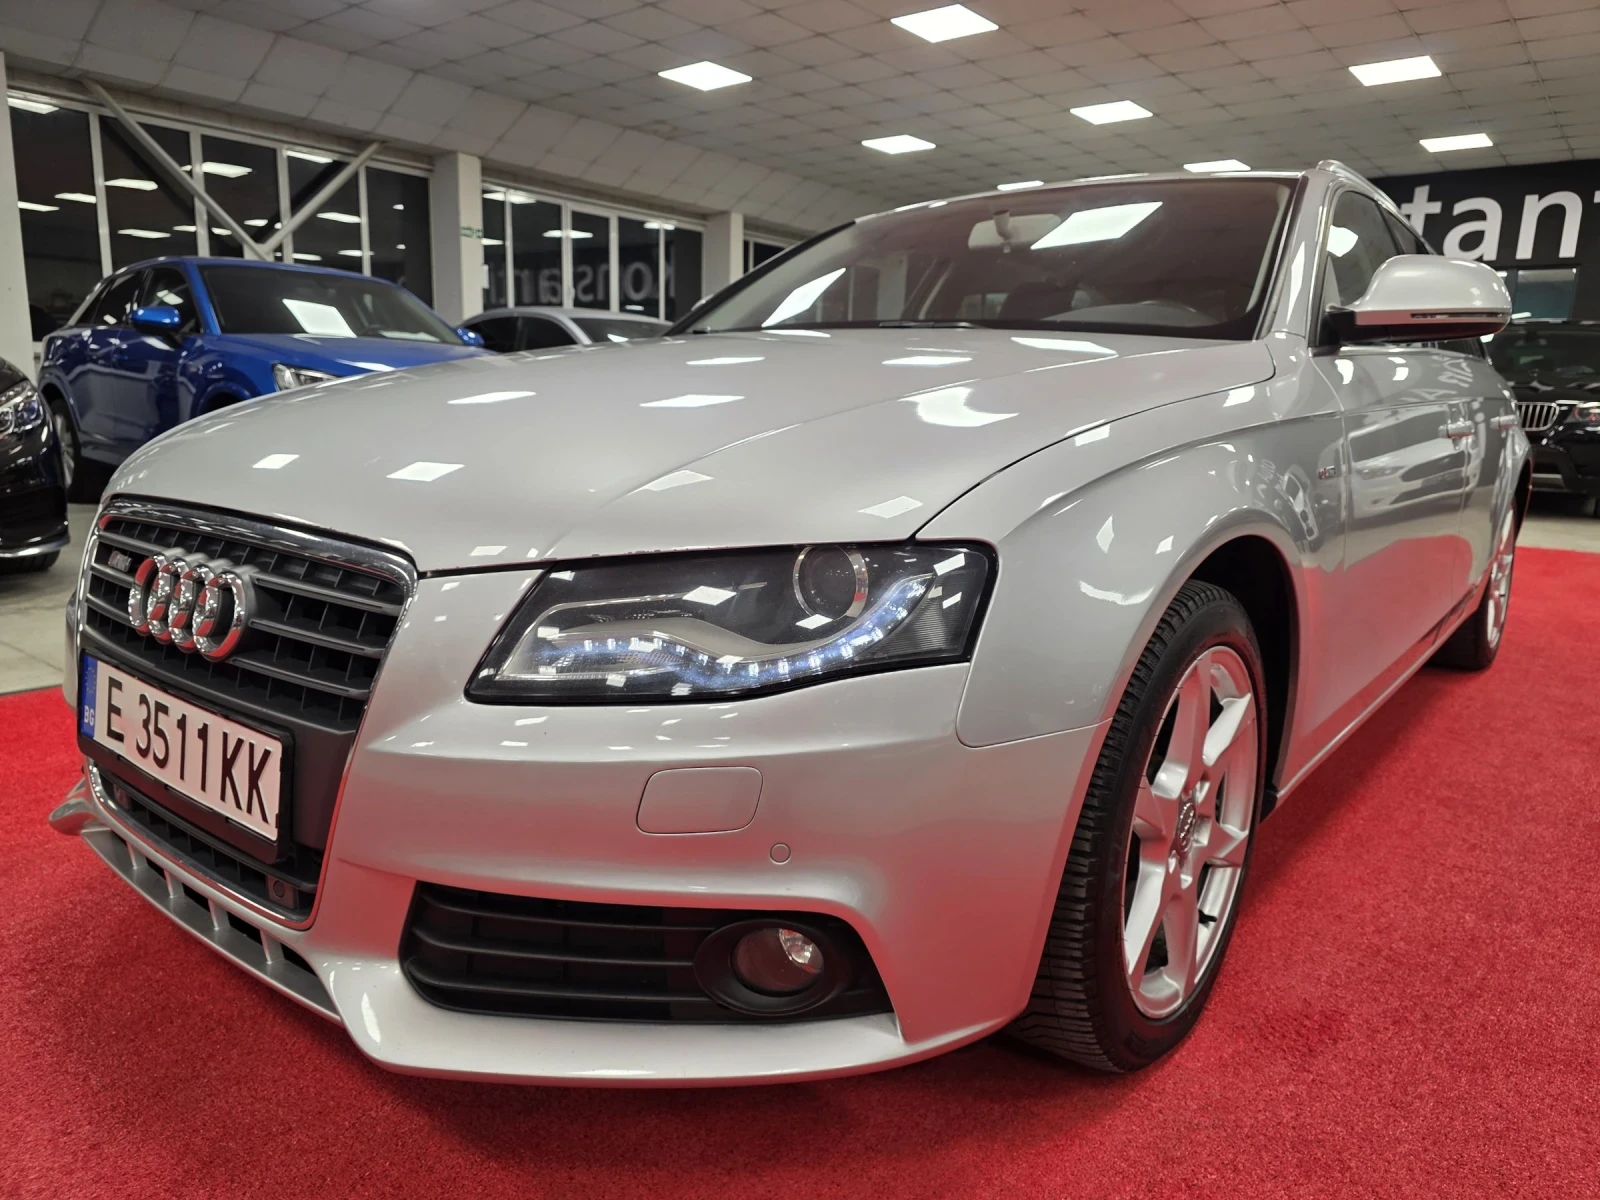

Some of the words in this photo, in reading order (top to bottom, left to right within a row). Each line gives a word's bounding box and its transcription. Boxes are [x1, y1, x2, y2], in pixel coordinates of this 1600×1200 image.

[1400, 184, 1600, 261] tan
[84, 705, 95, 726] BG
[106, 676, 125, 743] E
